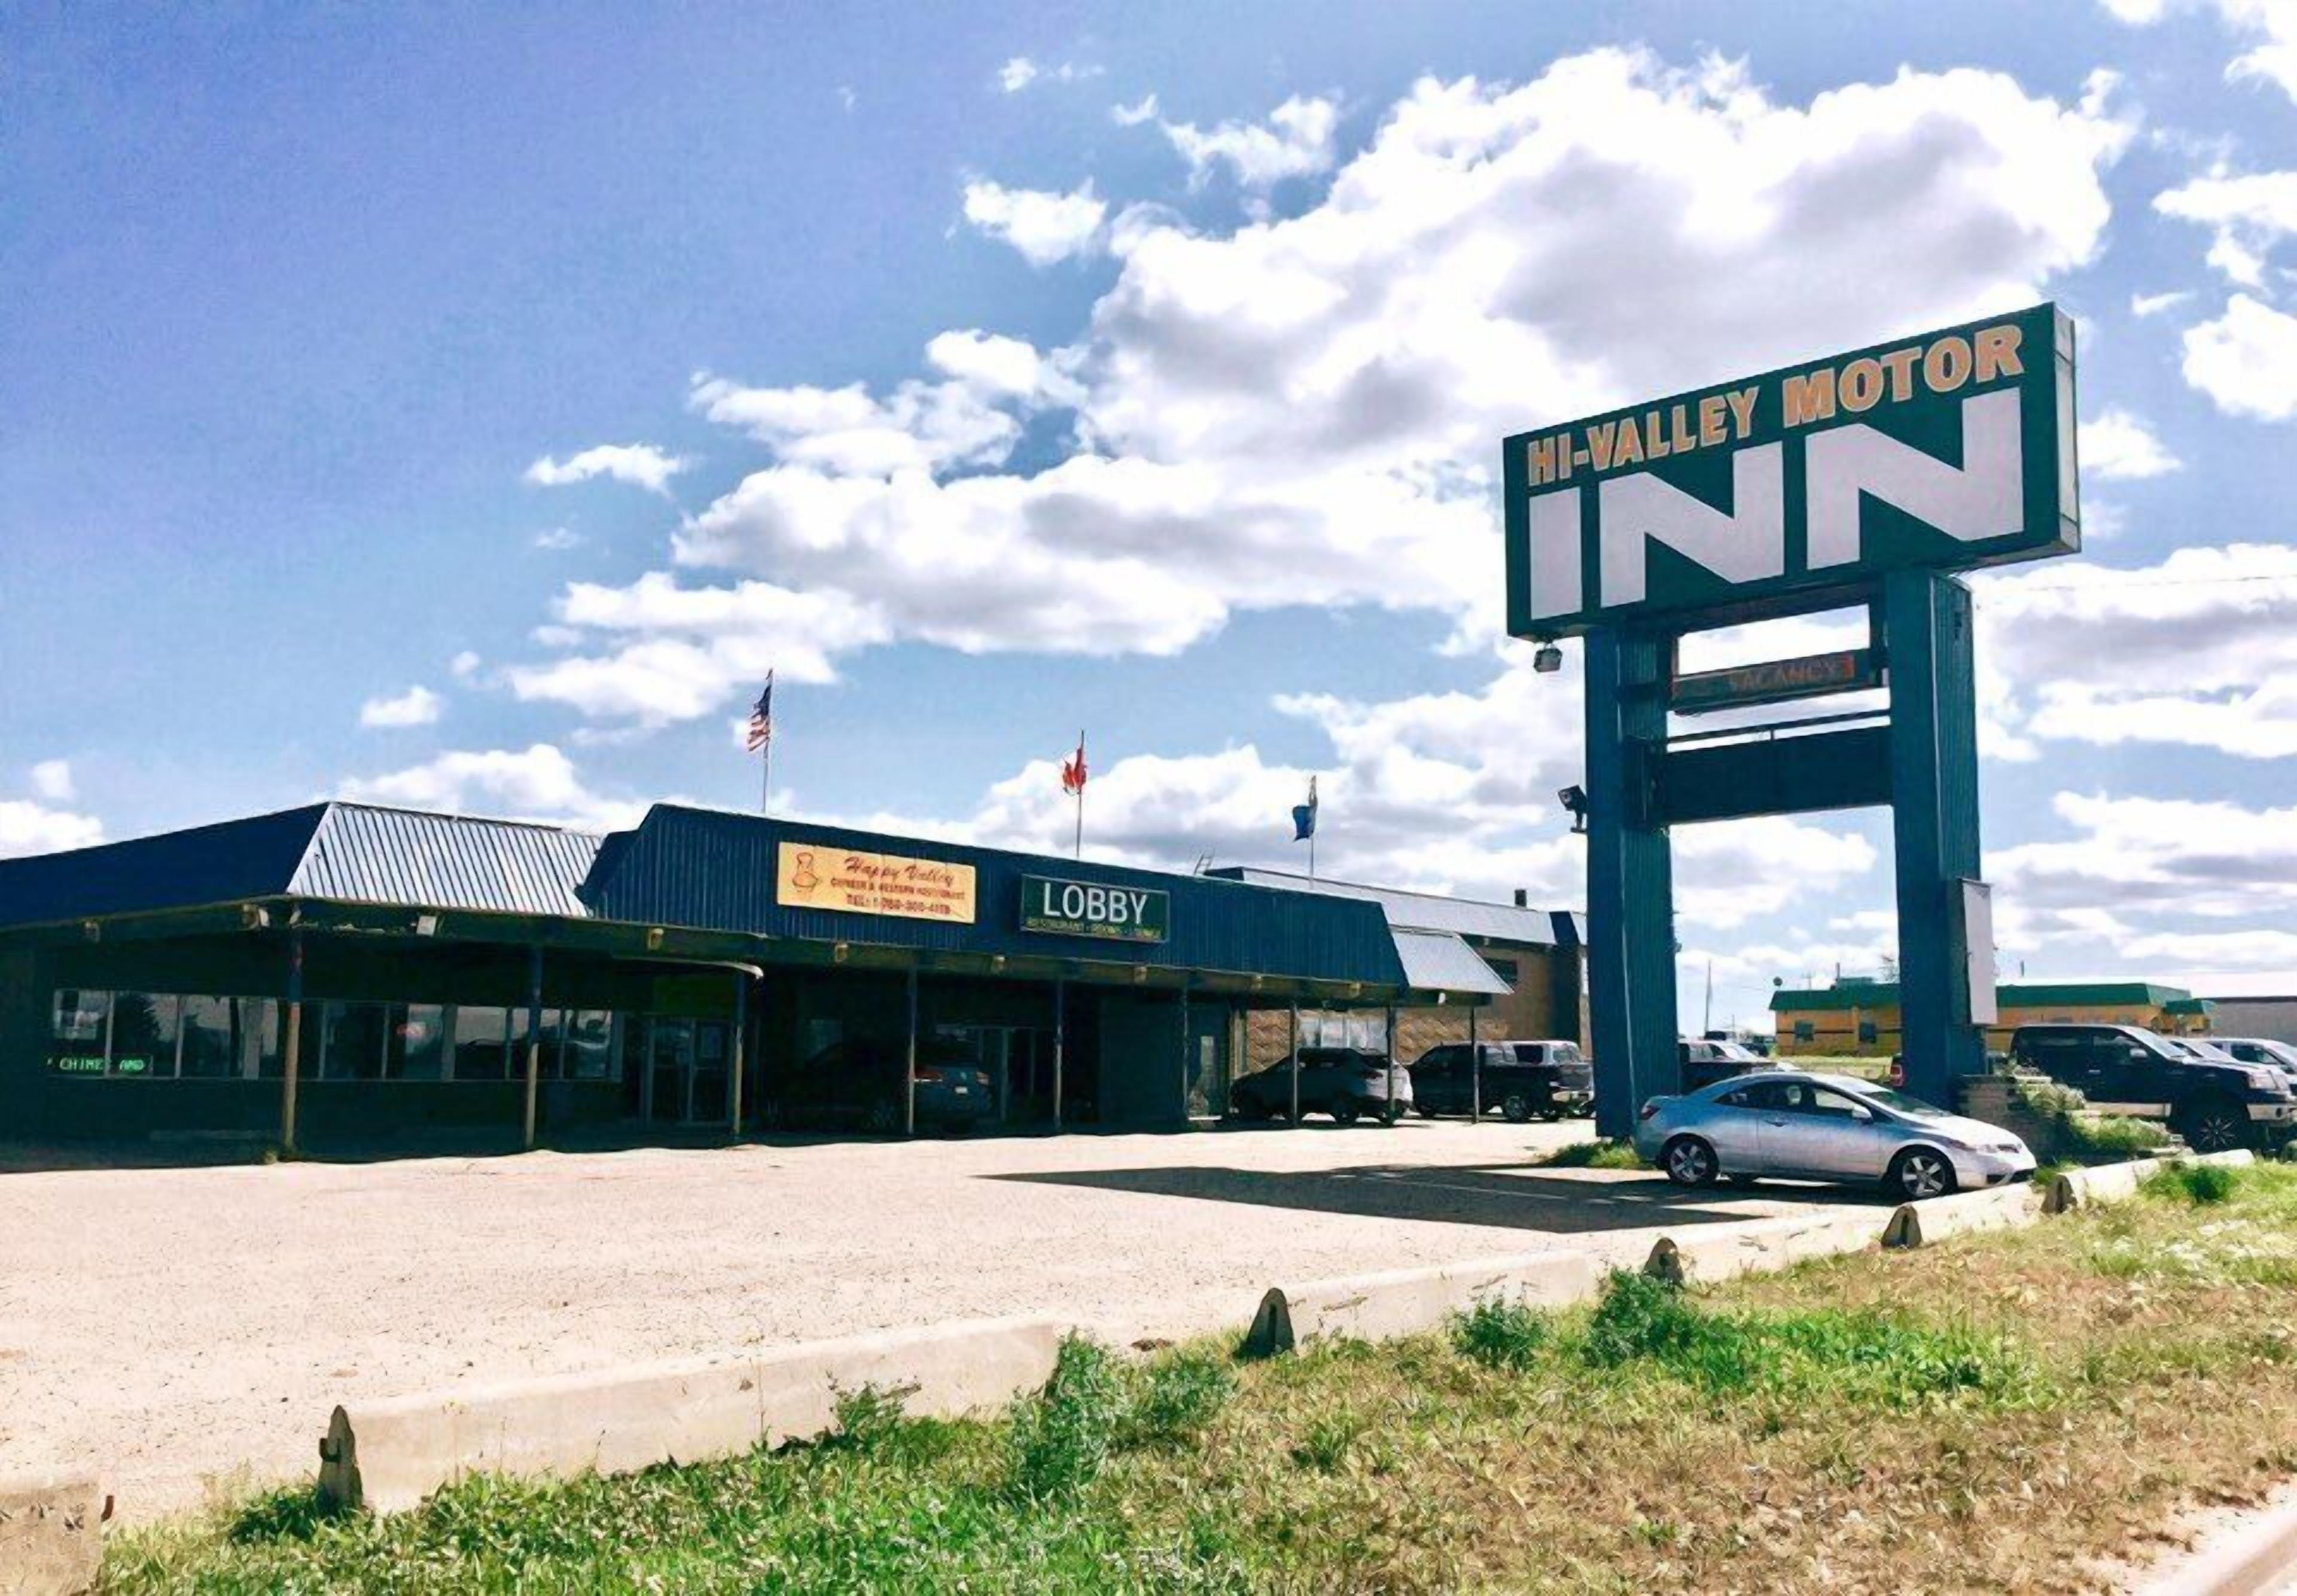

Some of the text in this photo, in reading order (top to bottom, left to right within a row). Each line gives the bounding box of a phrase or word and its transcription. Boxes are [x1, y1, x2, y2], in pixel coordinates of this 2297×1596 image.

[1527, 324, 2025, 487] HI-VALLEY MOTOR
[1528, 387, 2025, 621] INN
[844, 856, 955, 888] Happy Valley
[1043, 882, 1148, 925] LOBBY
